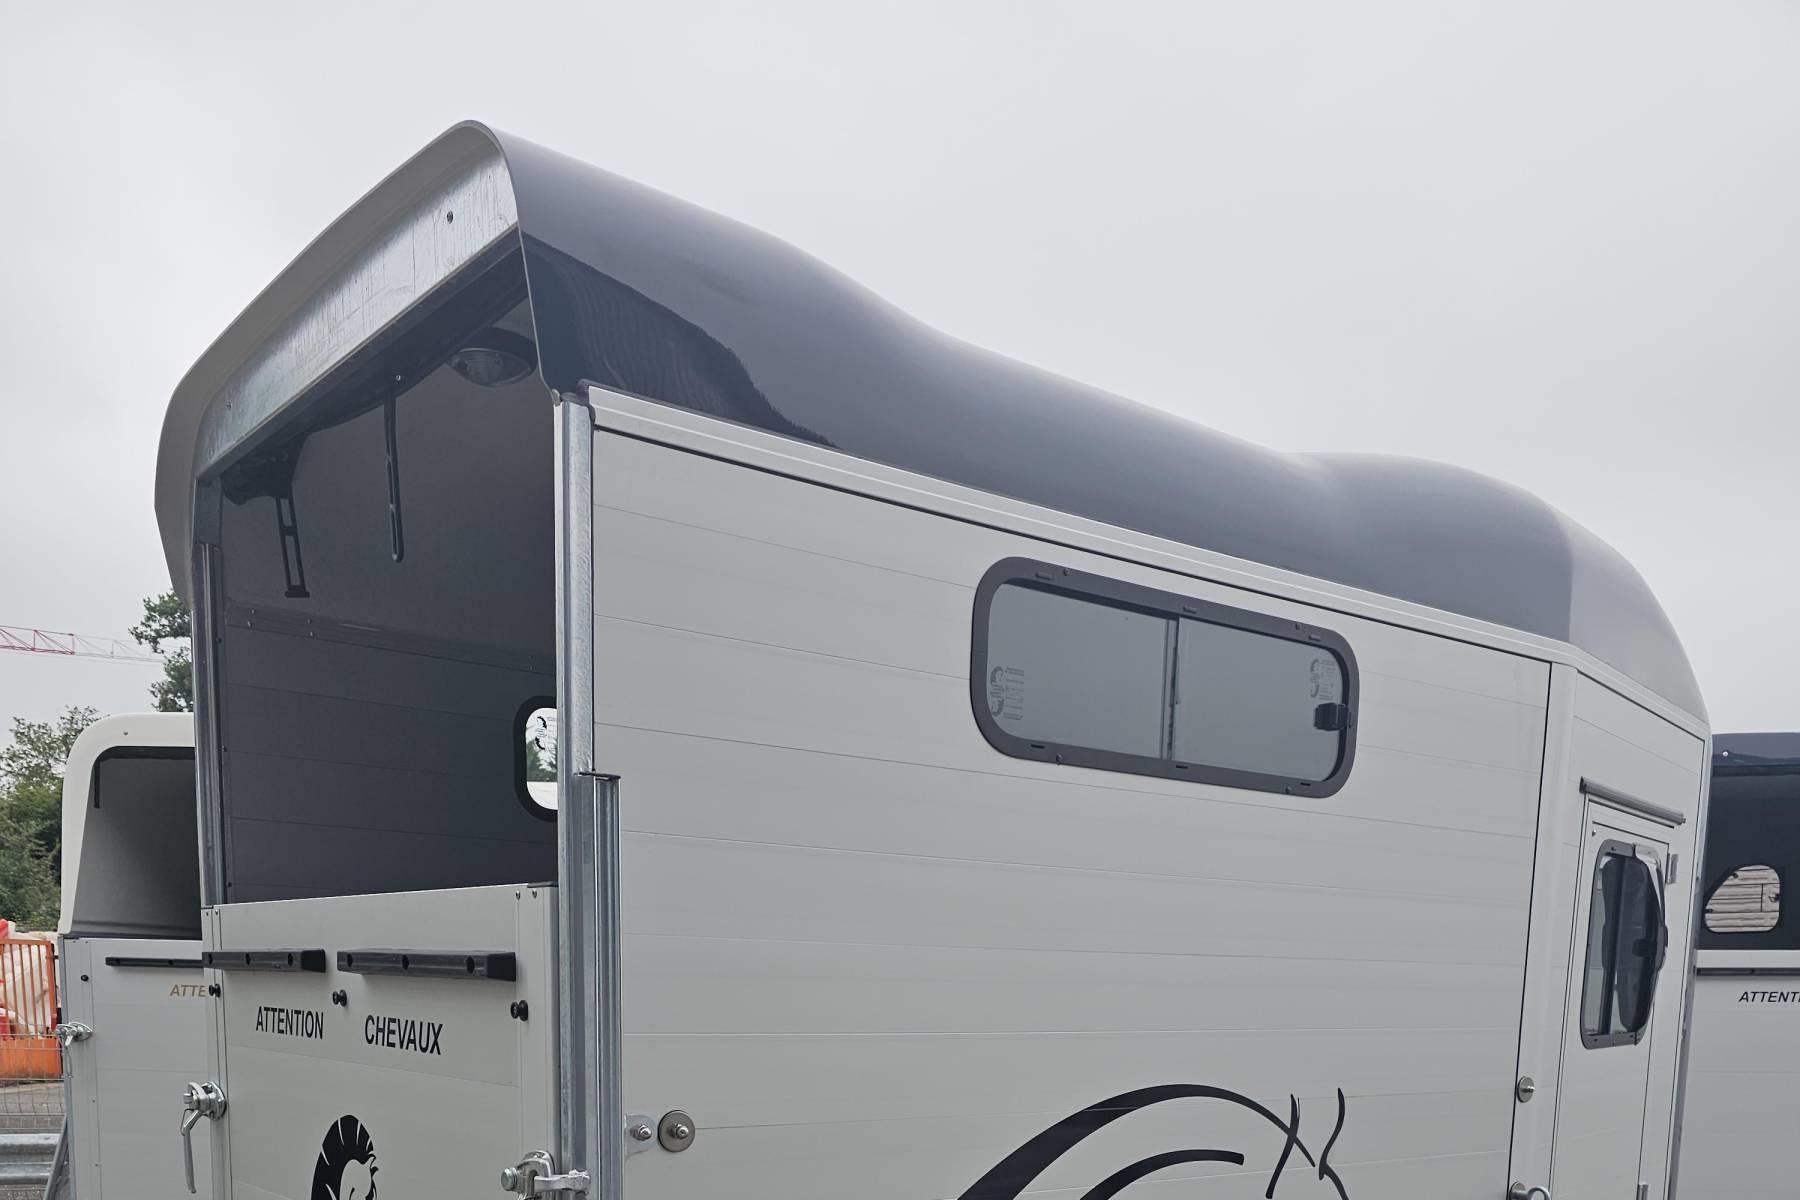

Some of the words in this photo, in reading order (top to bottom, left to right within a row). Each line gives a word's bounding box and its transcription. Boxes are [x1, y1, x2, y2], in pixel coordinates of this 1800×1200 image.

[1738, 991, 1800, 1003] ATTENT
[256, 1006, 324, 1040] ATTENTION
[365, 1014, 443, 1055] CHEVAUX
